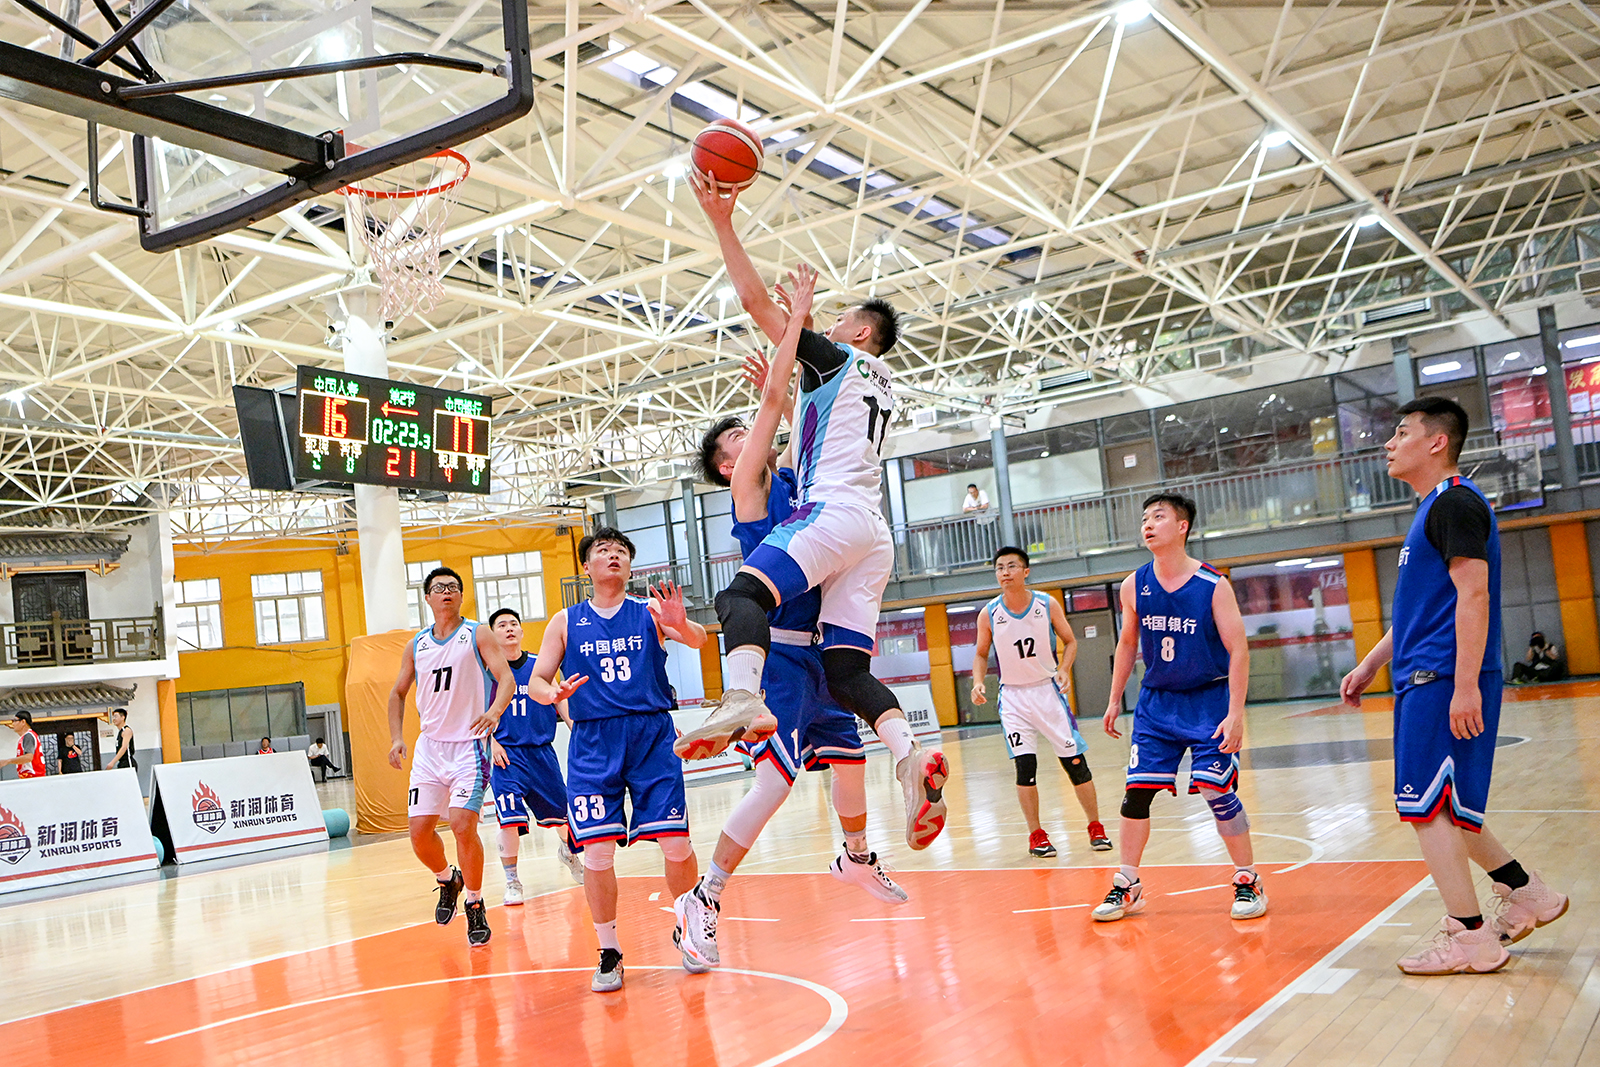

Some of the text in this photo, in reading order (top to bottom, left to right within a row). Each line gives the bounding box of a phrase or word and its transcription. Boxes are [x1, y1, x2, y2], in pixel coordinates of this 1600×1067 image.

[871, 370, 891, 388] 中国
[323, 396, 348, 438] 16
[452, 415, 474, 454] 17
[386, 446, 416, 478] 21
[1142, 614, 1197, 635] 中国银行
[580, 635, 643, 656] 中国银行
[1013, 637, 1037, 660] 12
[1160, 636, 1175, 662] 8
[432, 666, 453, 693] 77
[600, 656, 631, 683] 33
[510, 698, 527, 717] 11
[1008, 732, 1023, 748] 12
[1129, 744, 1139, 769] 8
[230, 793, 295, 819] 新润体育
[497, 793, 515, 812] 11
[574, 795, 606, 822] 33
[37, 817, 118, 847] 新润体育
[232, 818, 265, 829] XINRUN
[266, 813, 298, 825] SPORTS
[39, 844, 81, 858] XINRUN
[81, 838, 122, 853] SPORTS
